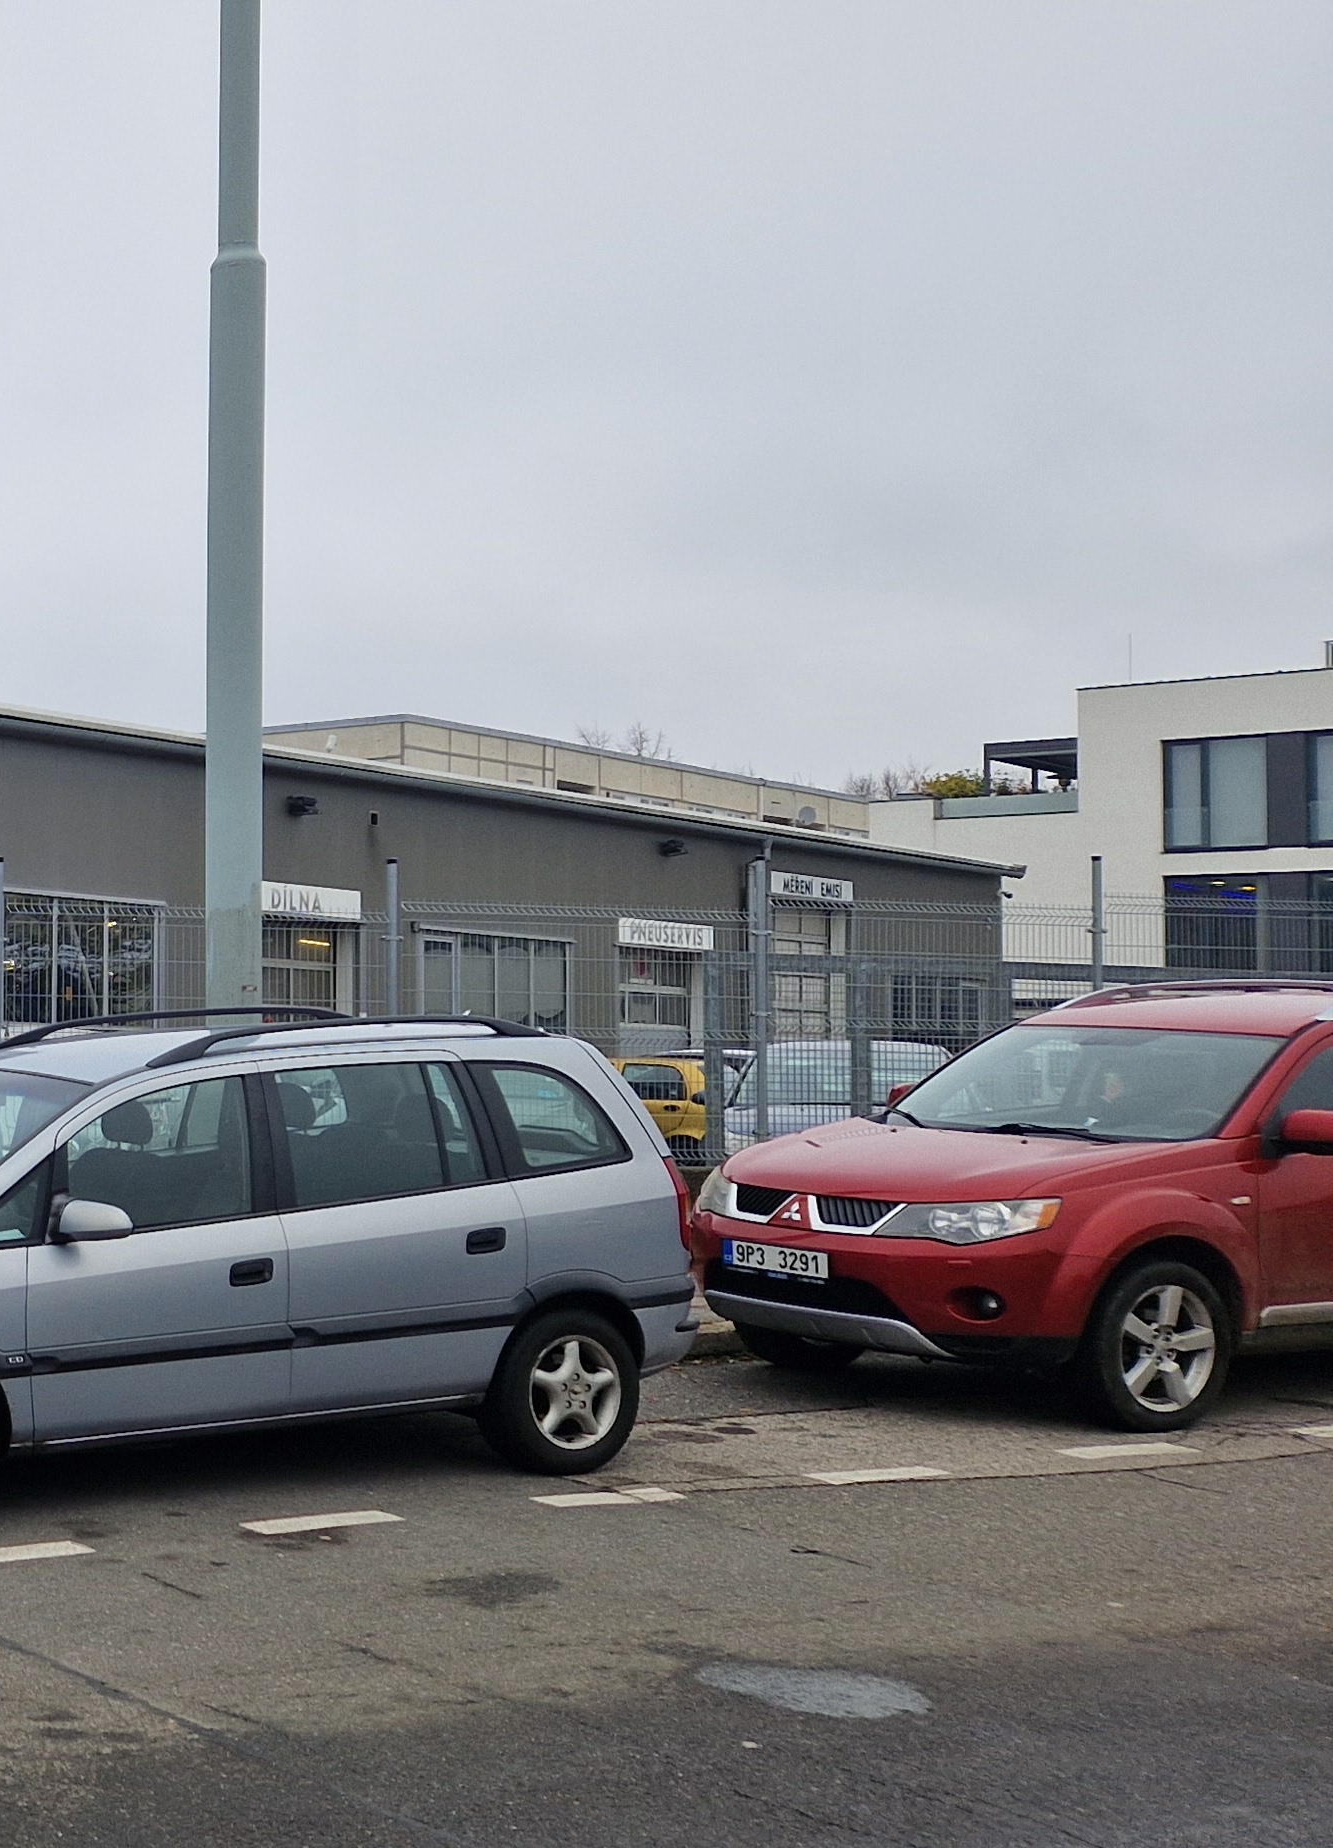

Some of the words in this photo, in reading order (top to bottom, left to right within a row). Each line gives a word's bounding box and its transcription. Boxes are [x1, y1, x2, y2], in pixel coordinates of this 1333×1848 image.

[271, 885, 323, 913] DÍLNA
[783, 875, 813, 896] MĚŘENÍ
[821, 881, 843, 899] EMISÍ
[630, 921, 704, 946] PNEUSERVIS
[735, 1244, 765, 1266] 9P3
[778, 1250, 819, 1275] 3291
